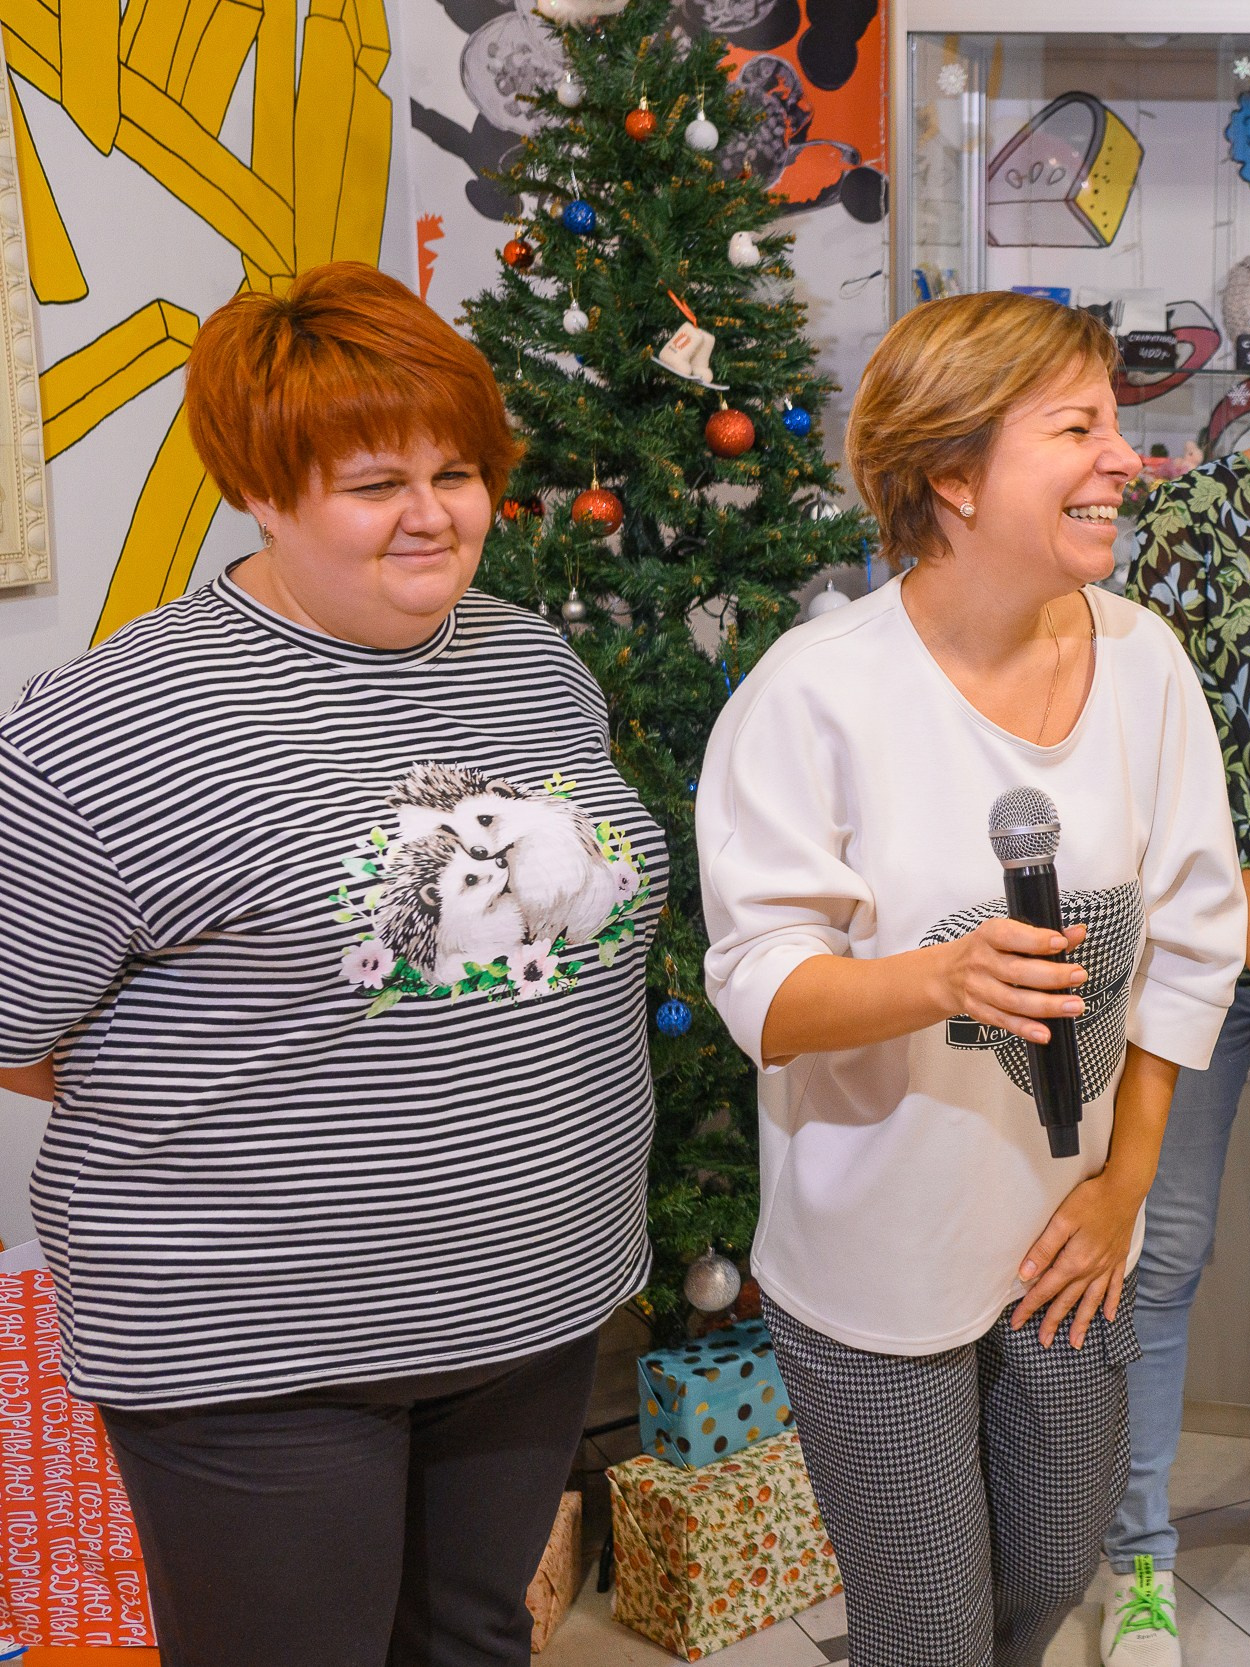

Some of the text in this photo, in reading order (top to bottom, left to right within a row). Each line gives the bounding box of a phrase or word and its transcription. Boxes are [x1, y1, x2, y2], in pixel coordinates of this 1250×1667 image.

[976, 989, 1114, 1043] New Style
[41, 1385, 75, 1530] ПОЗДРАВЛЯЮ!
[78, 1481, 113, 1622] ПОЗДРАВЛЯЮ!
